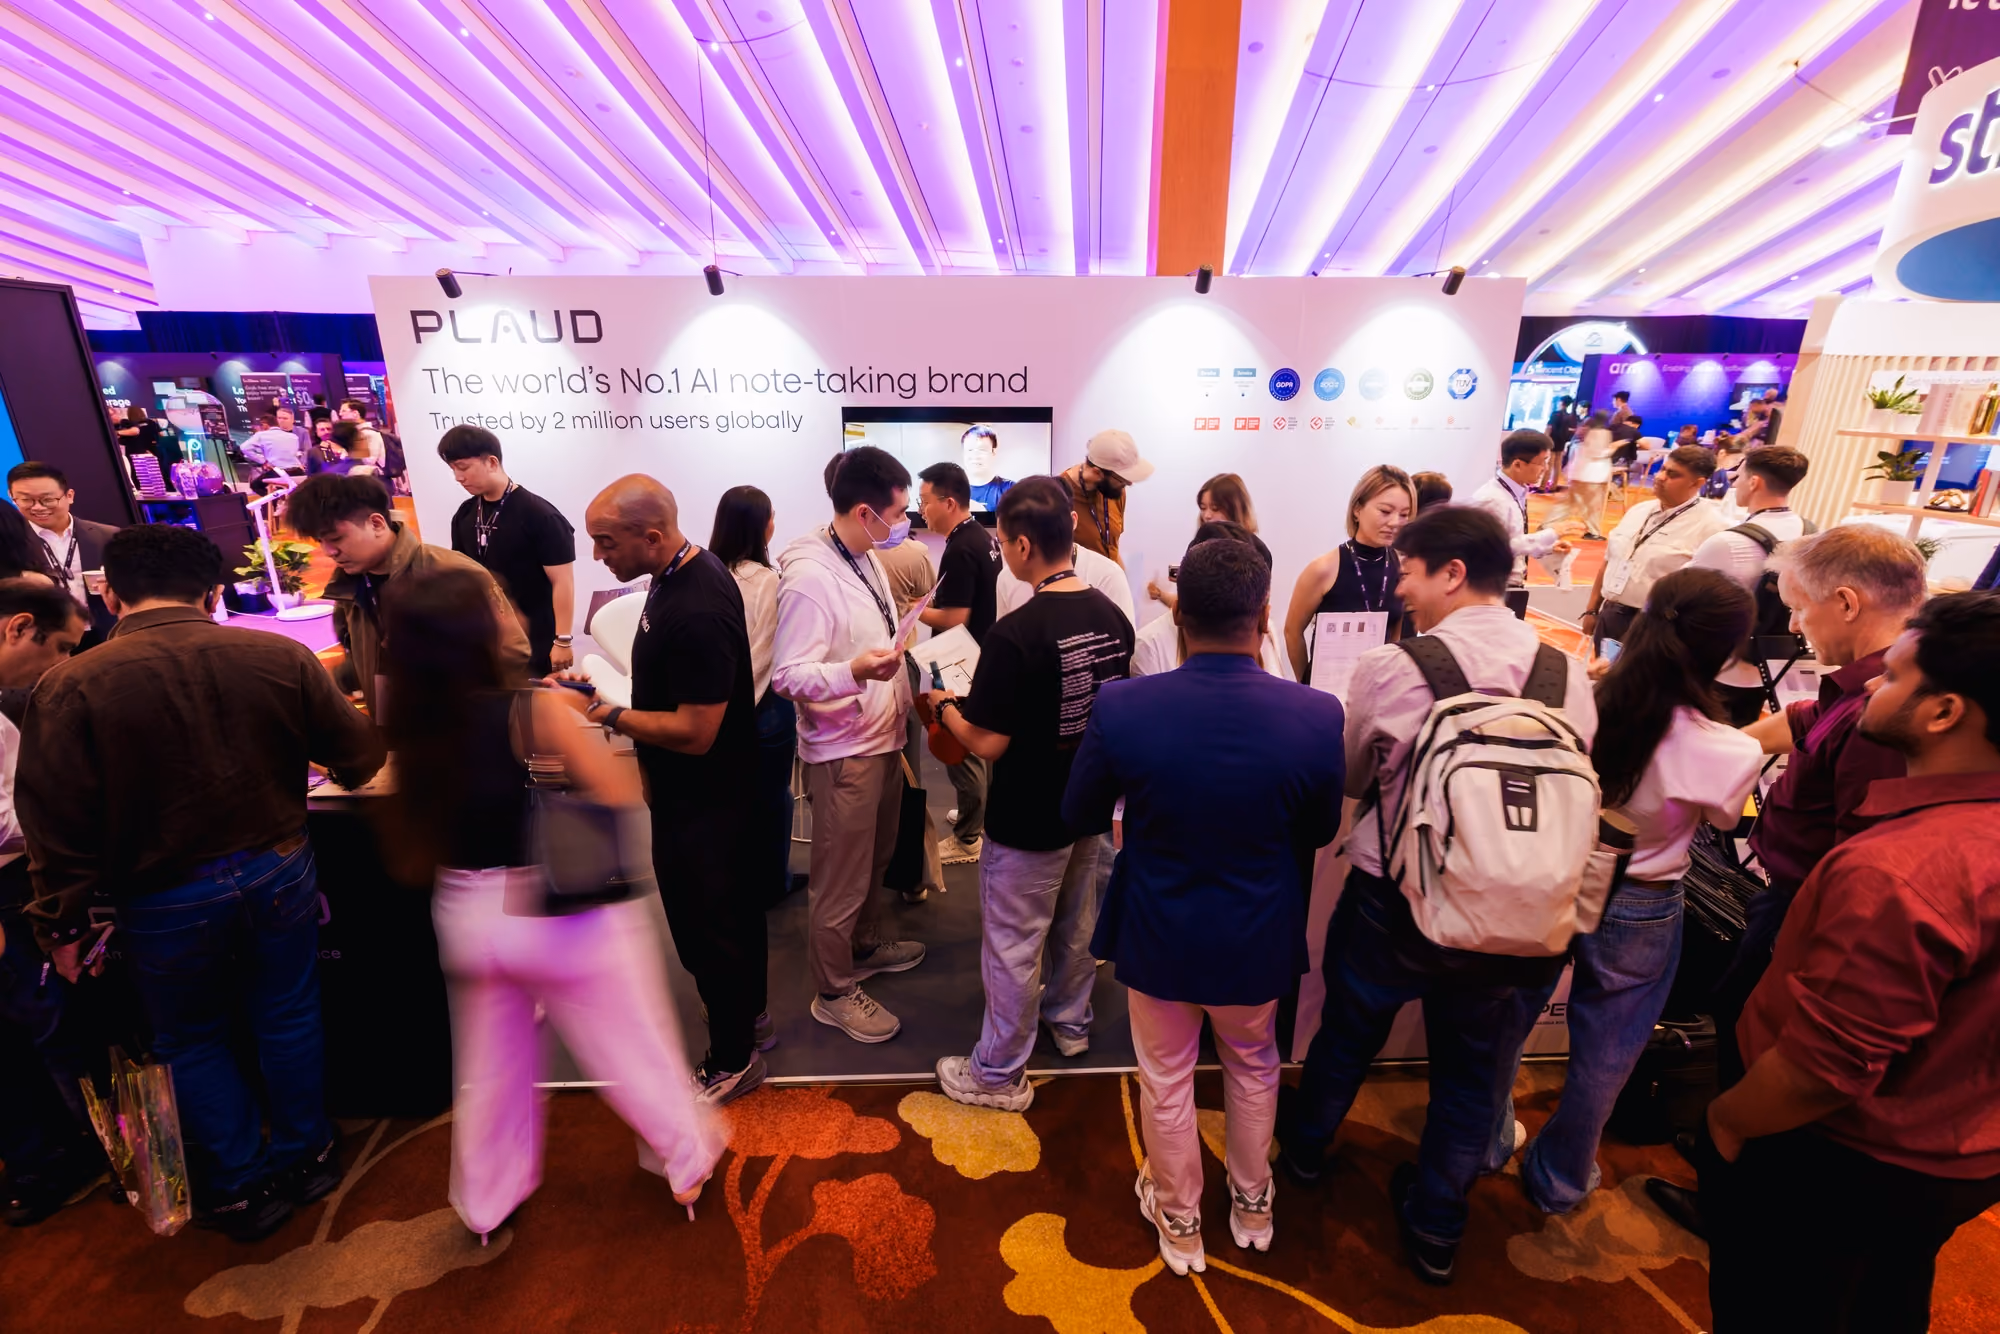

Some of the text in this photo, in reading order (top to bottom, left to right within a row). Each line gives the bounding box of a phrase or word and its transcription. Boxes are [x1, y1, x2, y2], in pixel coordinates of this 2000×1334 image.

[1928, 88, 2000, 185] st
[409, 309, 603, 344] PLAUD
[422, 365, 1029, 399] The world's No.1 AI note-taking brand
[429, 410, 803, 434] Trusted by 2 million users globally
